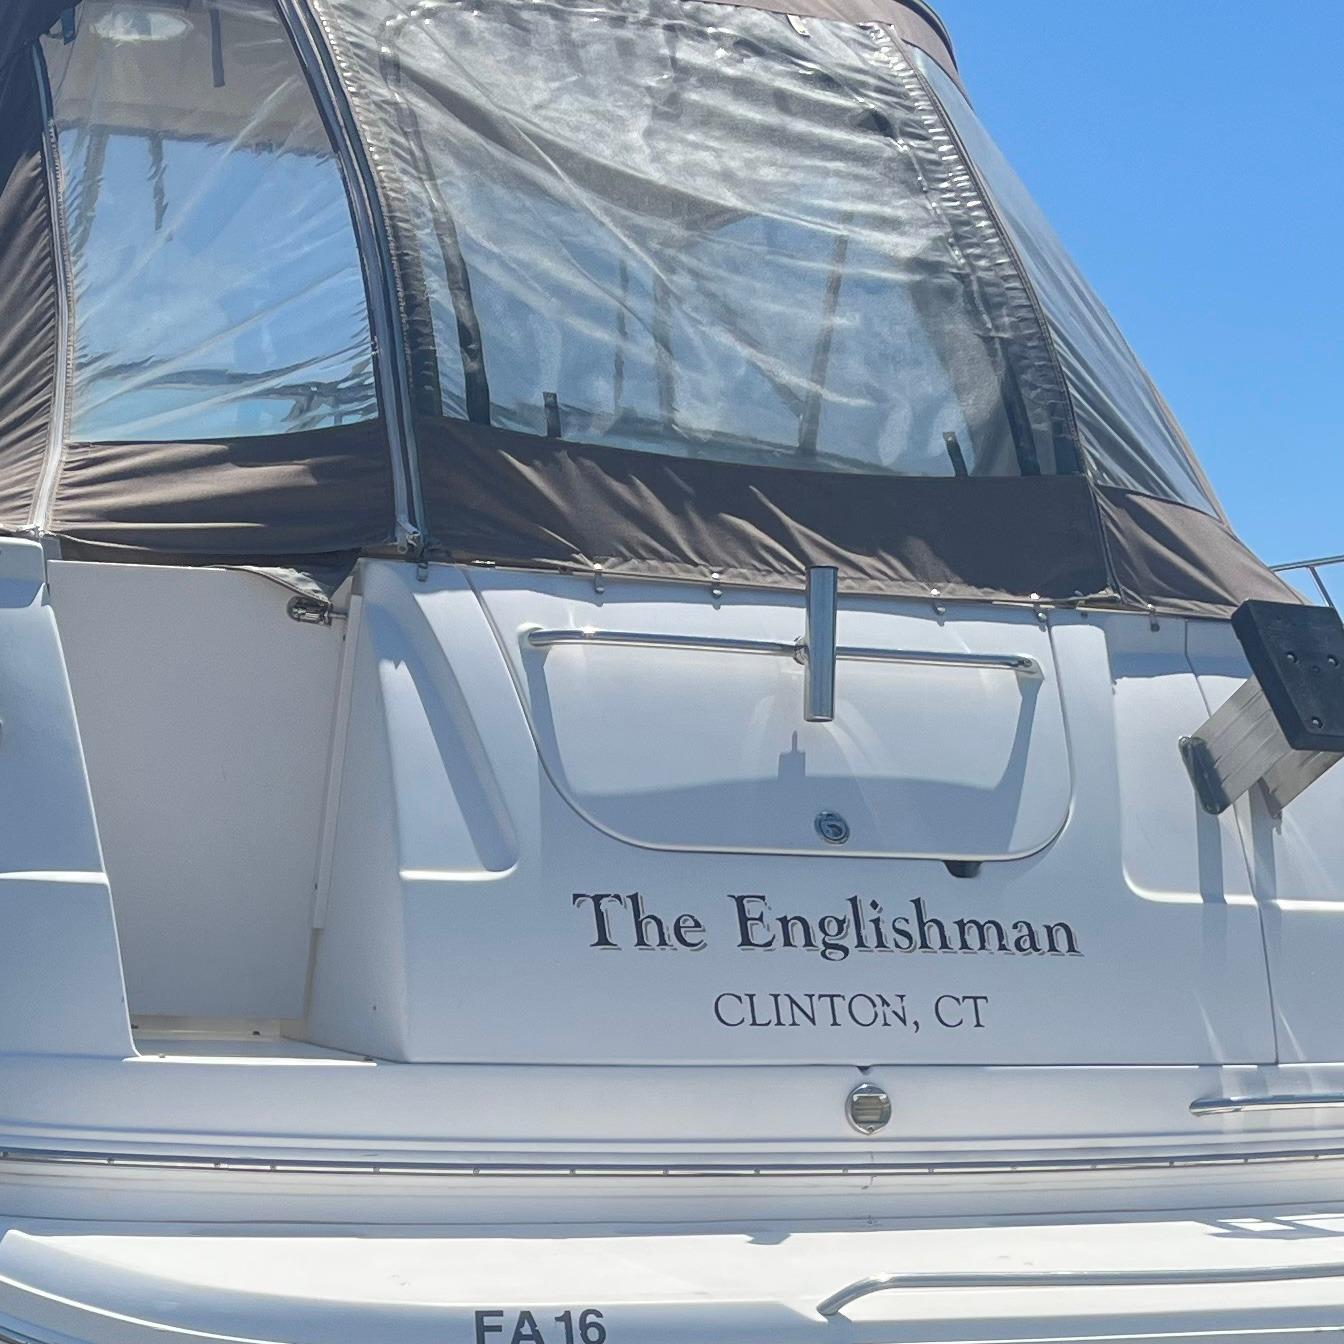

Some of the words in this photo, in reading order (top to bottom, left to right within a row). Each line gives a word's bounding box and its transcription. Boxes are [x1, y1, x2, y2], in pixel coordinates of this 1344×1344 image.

[572, 892, 708, 951] The
[728, 893, 1085, 962] Englishman
[713, 992, 921, 1034] CLINTON,
[933, 994, 989, 1029] CT
